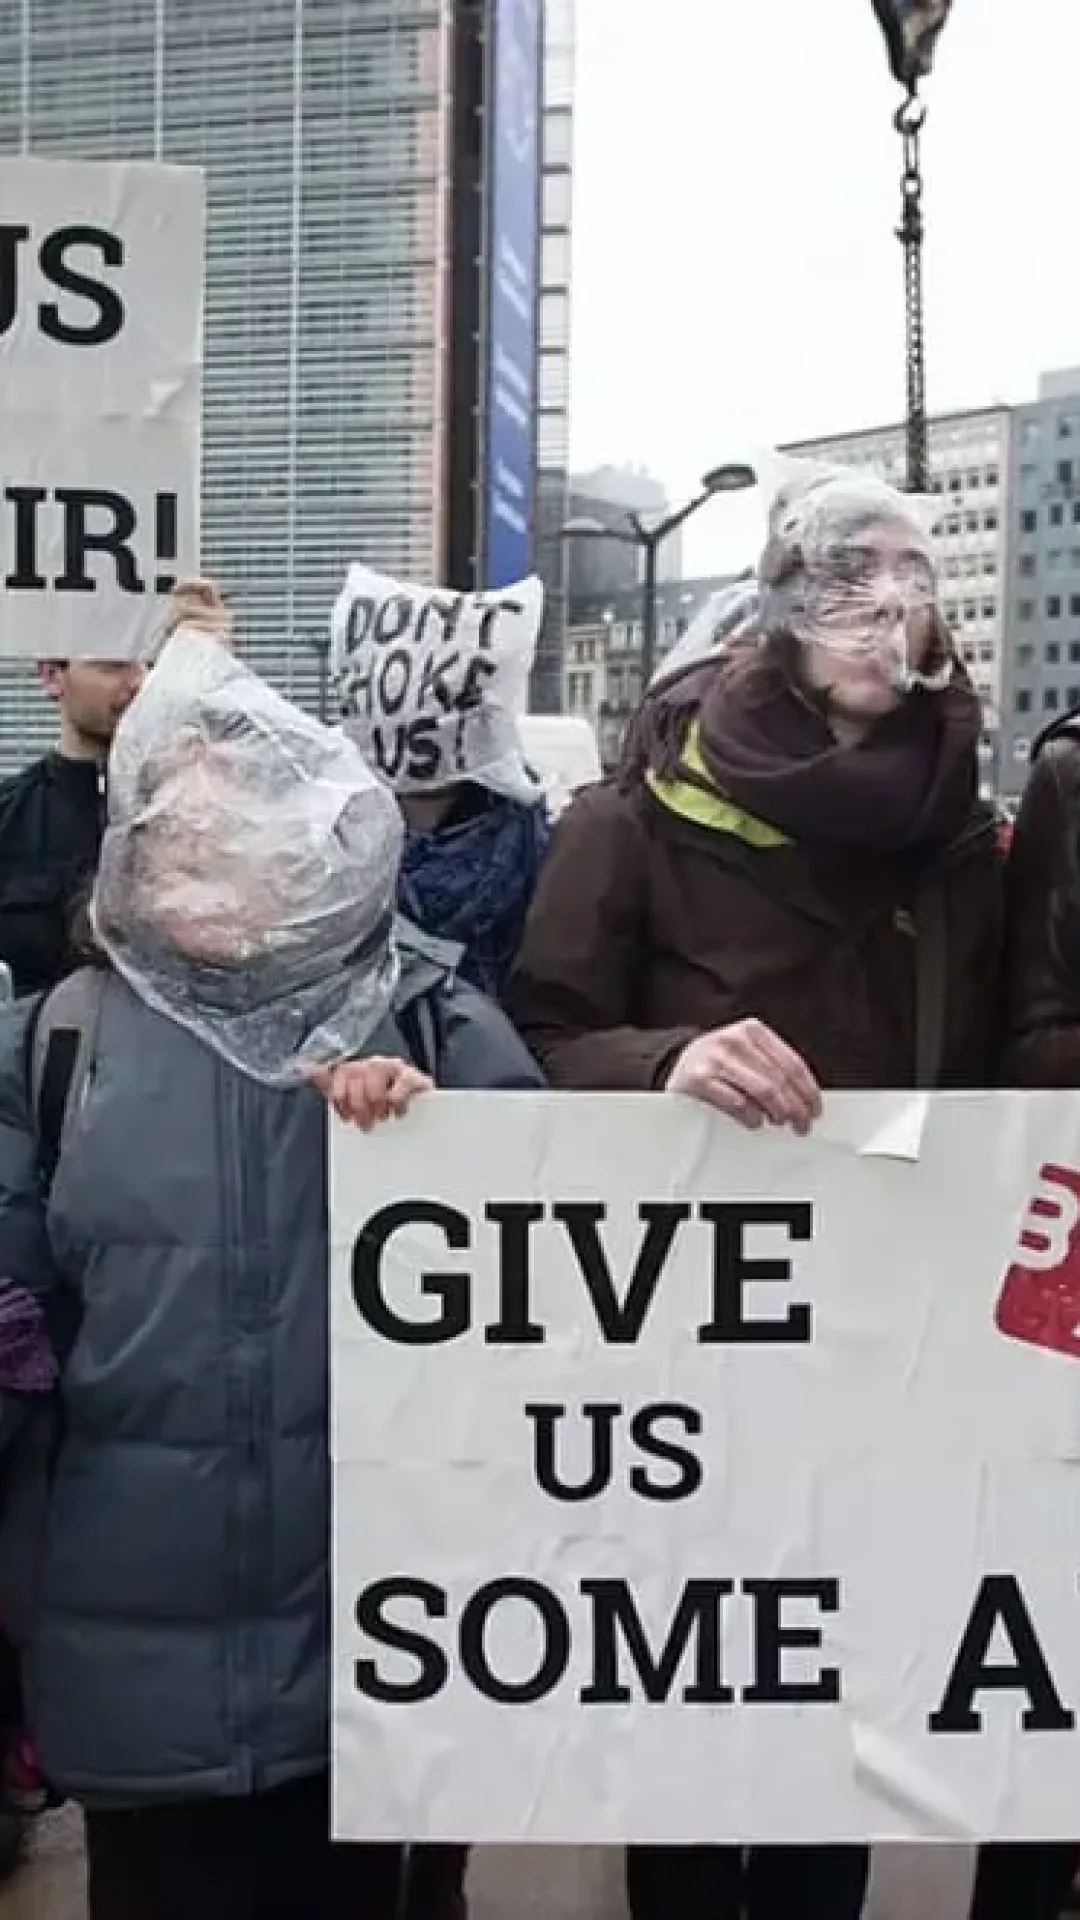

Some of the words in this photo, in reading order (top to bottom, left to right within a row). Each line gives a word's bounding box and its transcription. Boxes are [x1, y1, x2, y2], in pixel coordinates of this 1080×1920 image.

[0, 225, 125, 346] S
[4, 486, 178, 595] IR!
[350, 1200, 812, 1344] GIVE
[525, 1403, 702, 1501] US
[355, 1577, 841, 1704] SOME
[928, 1574, 1079, 1732] A
